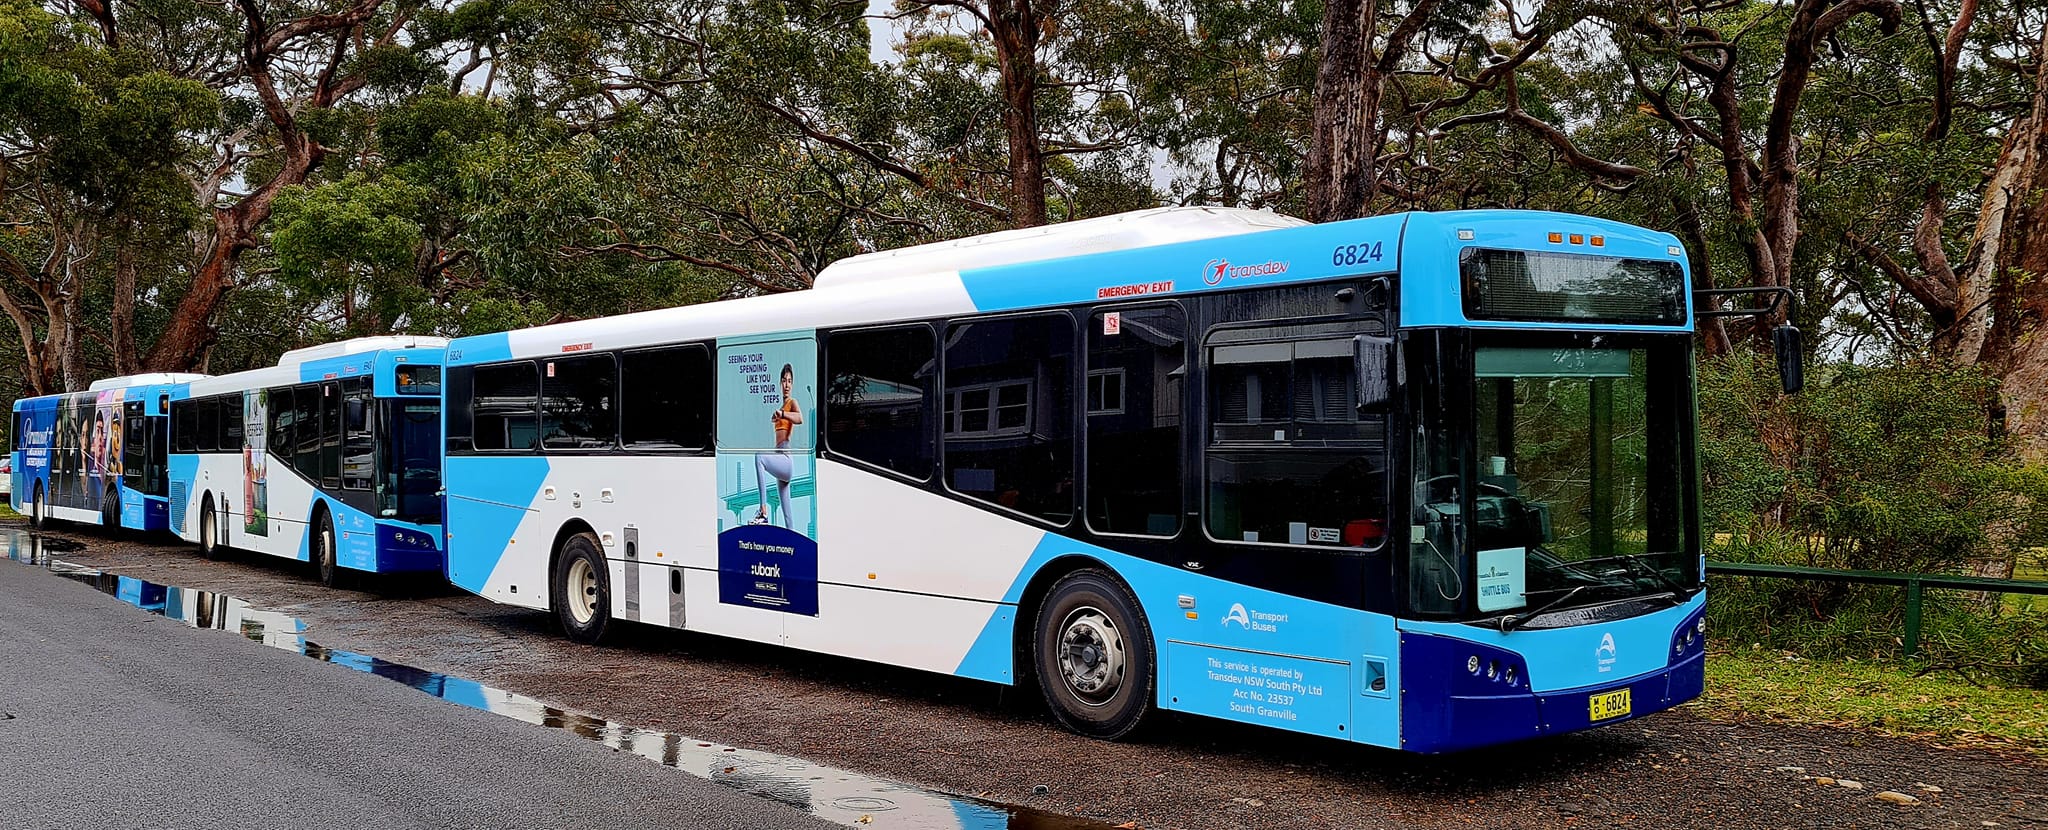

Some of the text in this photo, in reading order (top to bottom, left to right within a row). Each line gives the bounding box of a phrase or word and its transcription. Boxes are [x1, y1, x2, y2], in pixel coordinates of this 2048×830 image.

[1332, 240, 1383, 267] 6824
[1229, 260, 1290, 278] transdev
[1098, 281, 1173, 298] EMERGENCY EXIT
[450, 350, 463, 361] 6824
[728, 353, 763, 364] SEEING YOUR
[739, 363, 767, 374] SPENDING
[746, 374, 771, 383] LIKE YOU
[749, 384, 776, 394] SEE YOUR
[763, 394, 780, 404] STEPS
[738, 540, 795, 556] That's how you money
[1501, 584, 1511, 594] BUS
[1250, 610, 1288, 623] Transport
[1252, 621, 1277, 632] Buses
[1208, 657, 1304, 681] This service is operated by
[1208, 670, 1323, 696] Transdev NSW South Pty Ltd
[1233, 688, 1294, 706] Acc No. 23537
[1230, 701, 1297, 721] South Granville
